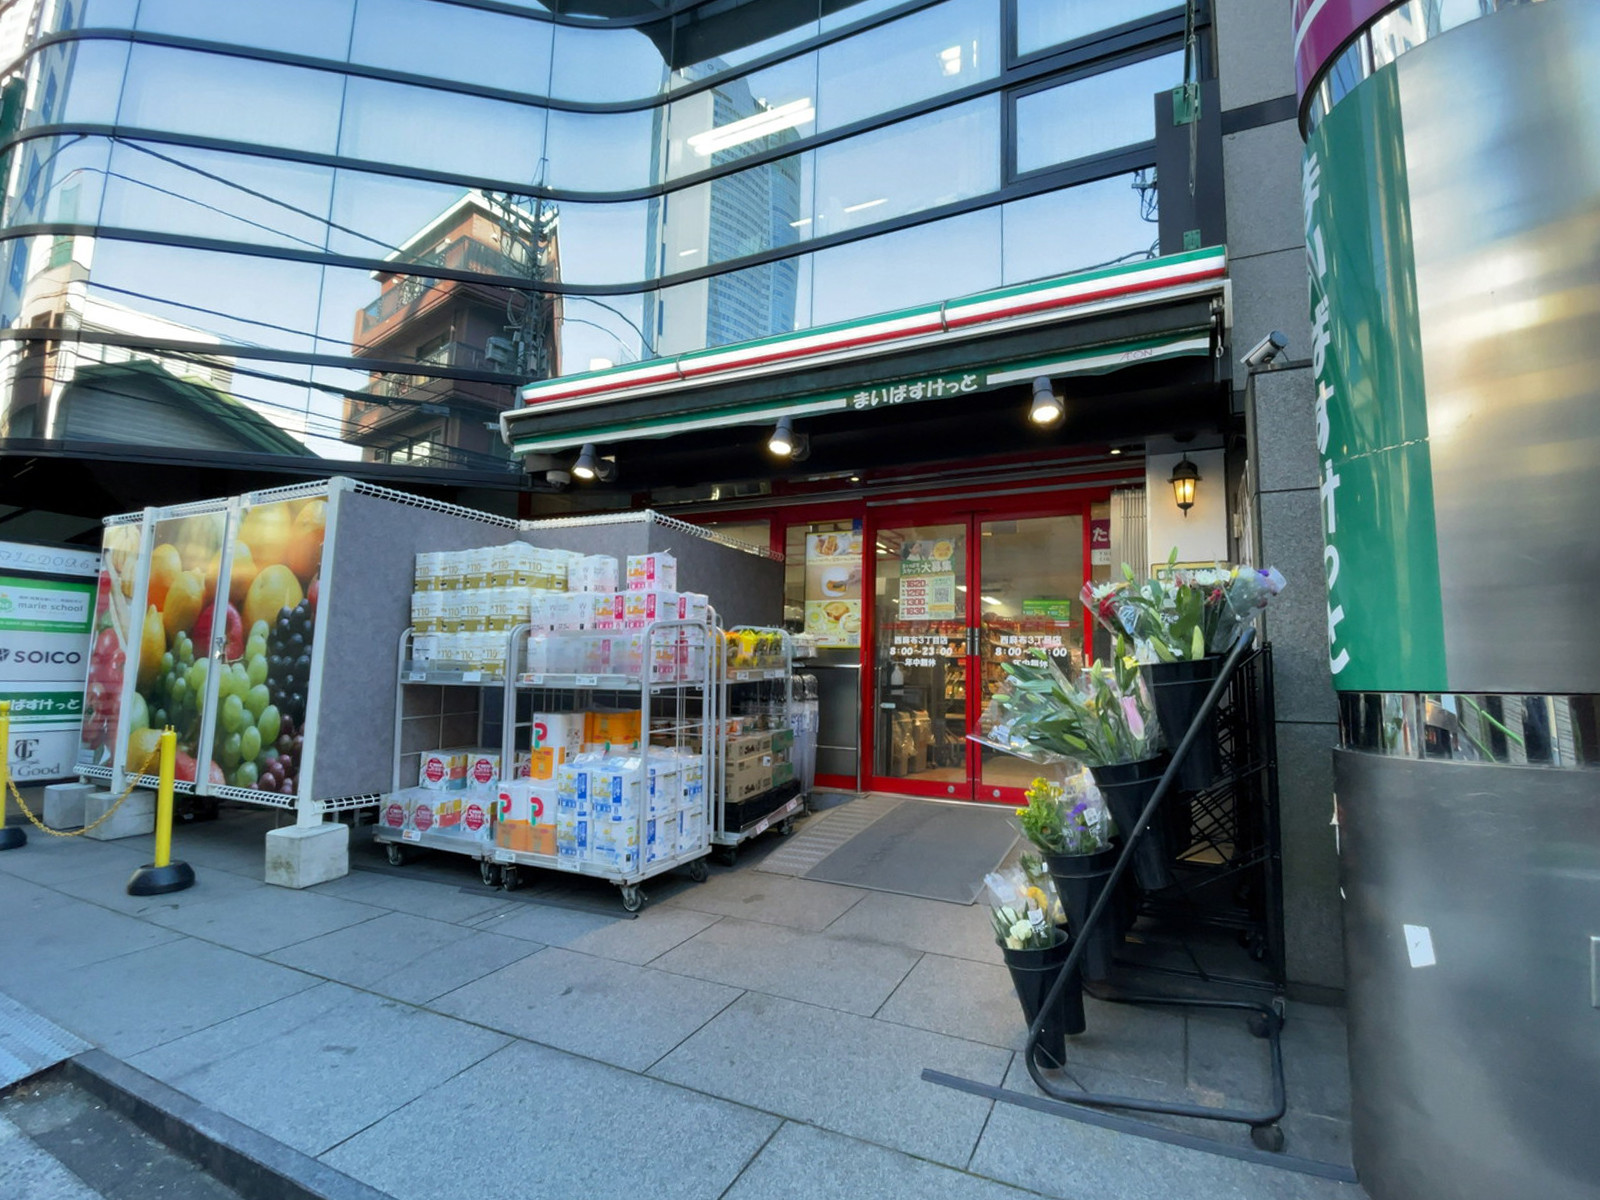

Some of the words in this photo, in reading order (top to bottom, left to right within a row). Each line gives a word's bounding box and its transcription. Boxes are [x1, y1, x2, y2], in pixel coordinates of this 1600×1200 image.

[853, 374, 978, 410] まいばすけっと
[18, 602, 47, 610] marie
[51, 603, 83, 612] school
[14, 651, 81, 664] SOICO
[18, 762, 61, 777] Good
